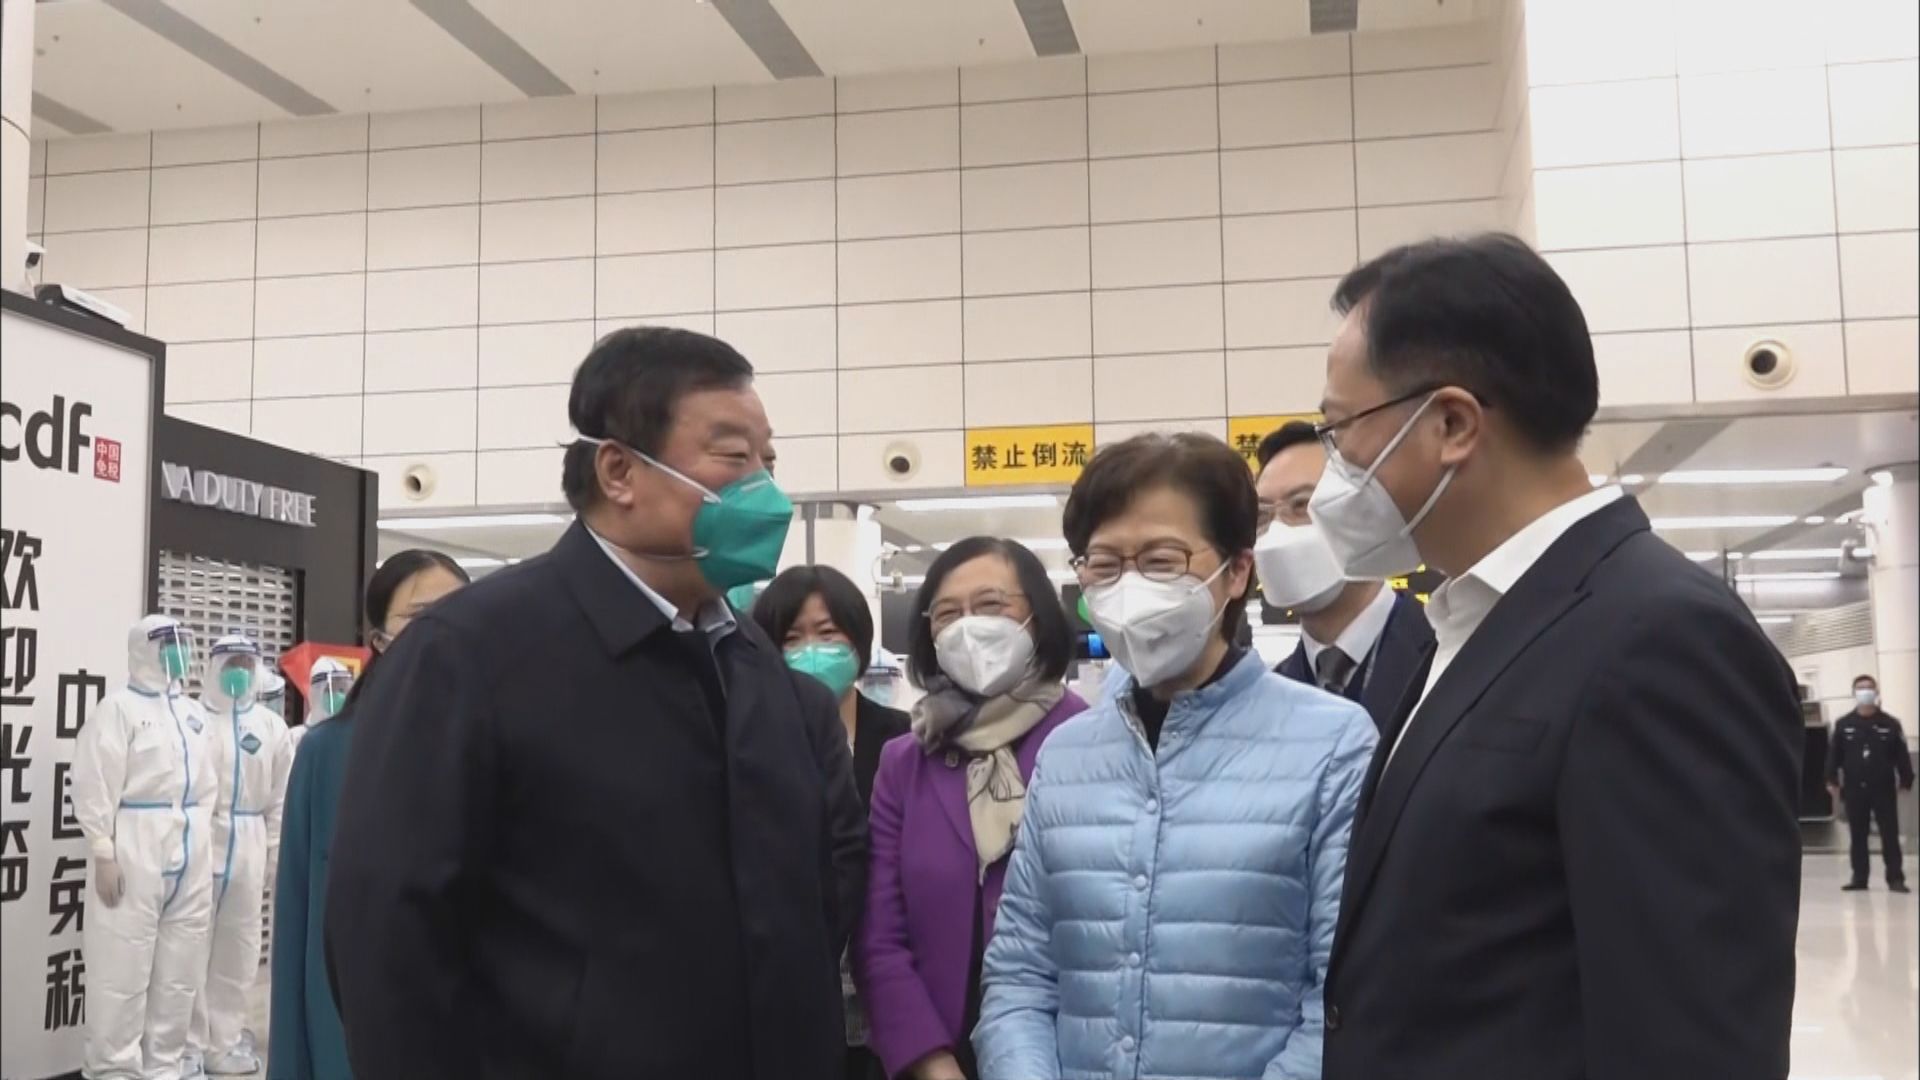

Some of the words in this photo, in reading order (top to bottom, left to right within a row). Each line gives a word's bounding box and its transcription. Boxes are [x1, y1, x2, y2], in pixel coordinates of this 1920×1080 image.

[1, 394, 92, 474] cdf
[96, 440, 120, 462] 中国
[972, 440, 1087, 471] 禁止倒流
[202, 470, 264, 516] DUTY
[270, 487, 317, 527] FREE
